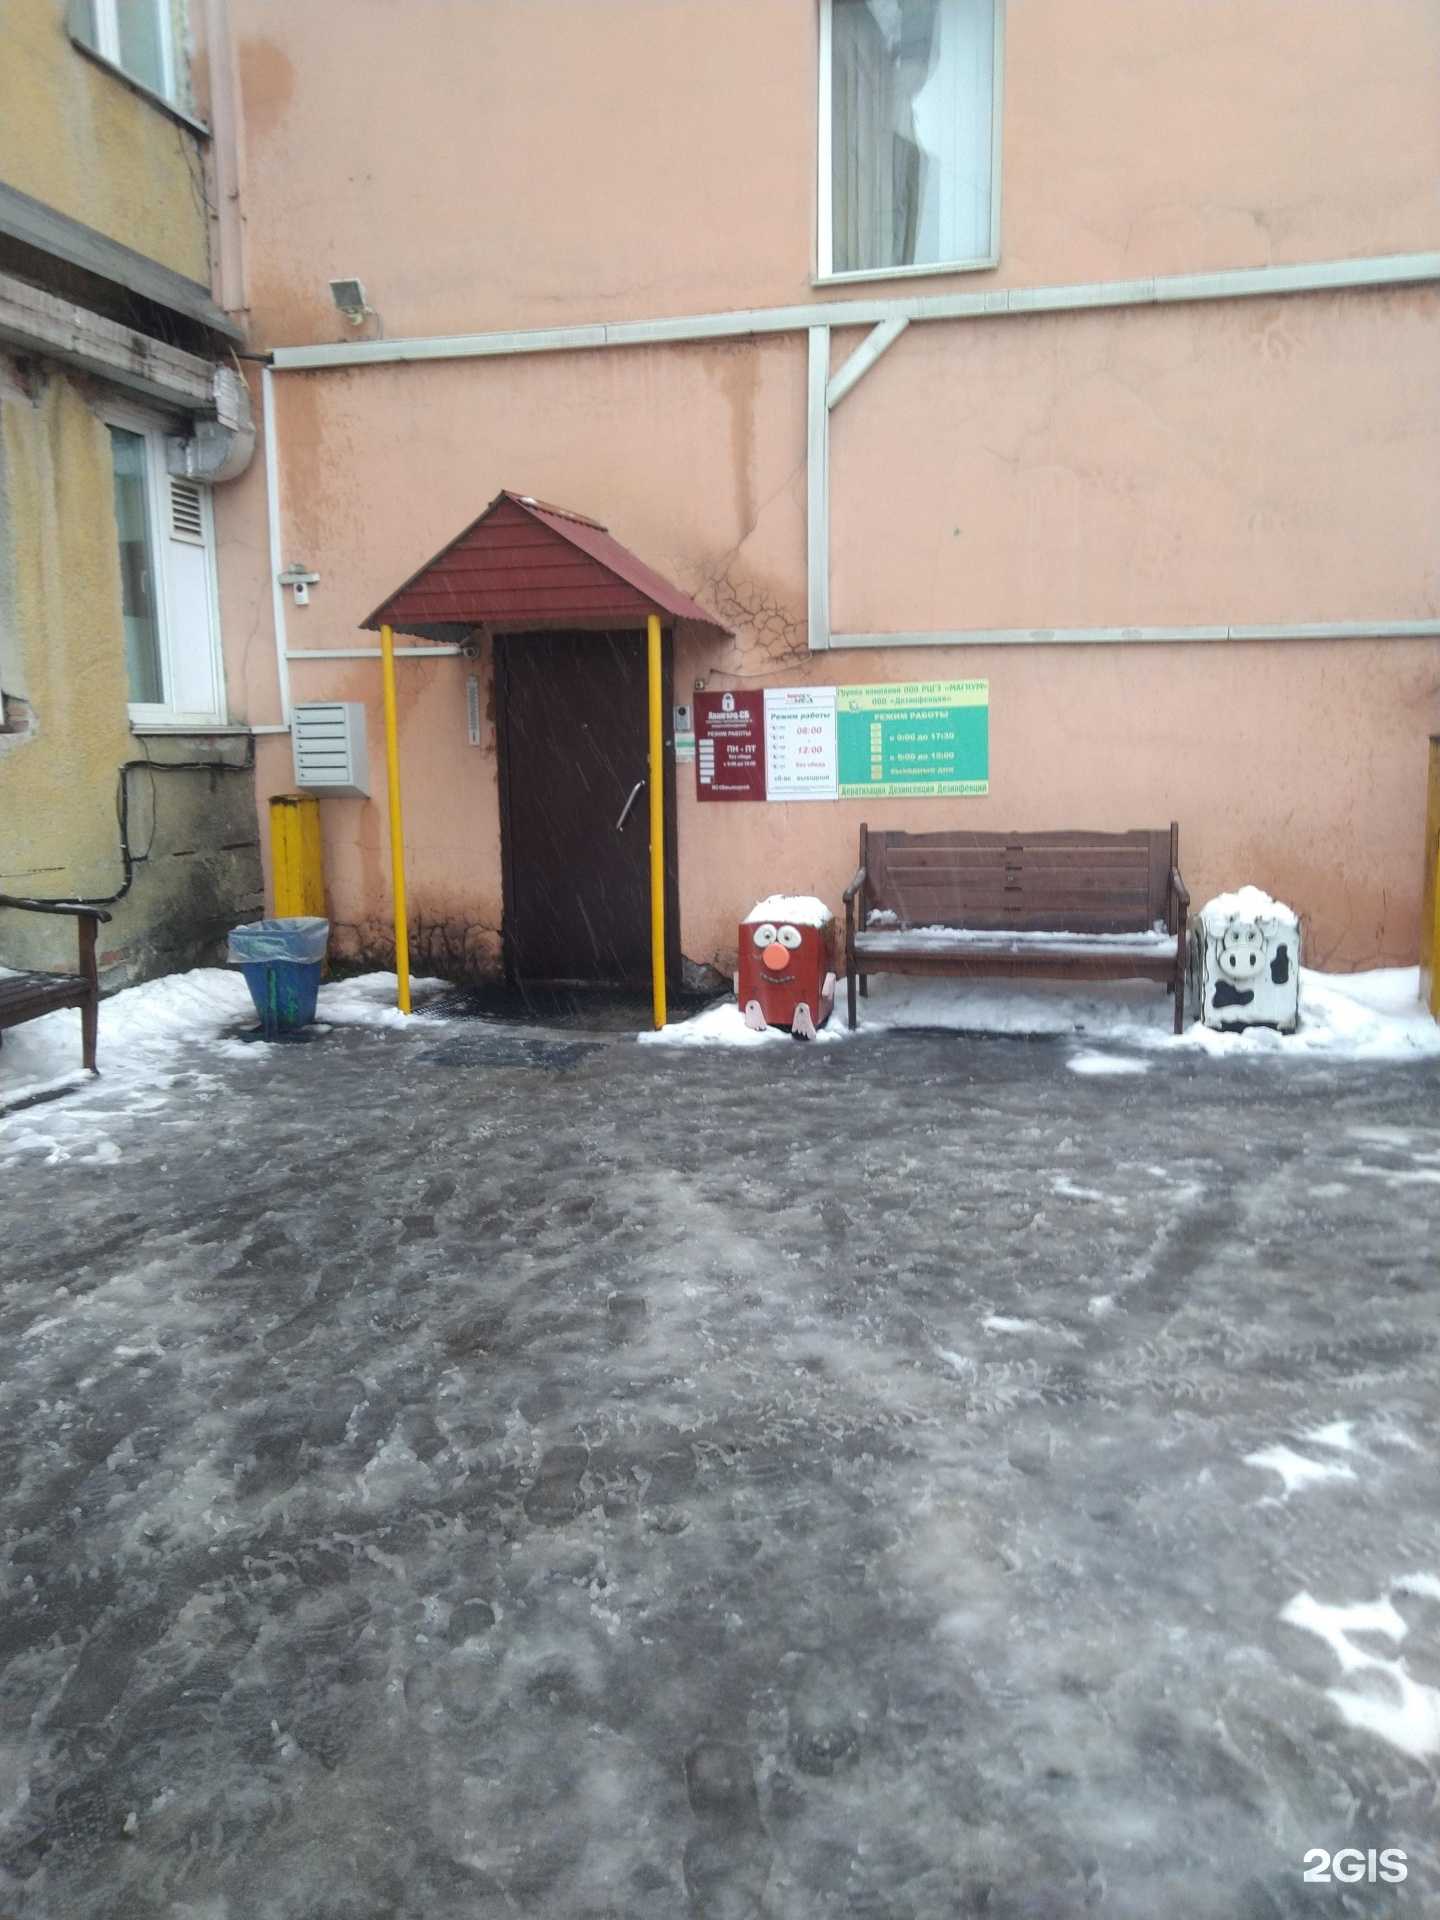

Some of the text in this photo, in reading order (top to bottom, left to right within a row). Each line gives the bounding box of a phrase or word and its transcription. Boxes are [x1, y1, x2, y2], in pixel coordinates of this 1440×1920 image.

[770, 711, 831, 721] Режим работы
[874, 711, 949, 721] РЕЖИМ РАБОТЫ
[796, 726, 823, 735] 08:00
[726, 744, 739, 753] ПН
[745, 744, 757, 753] ПТ
